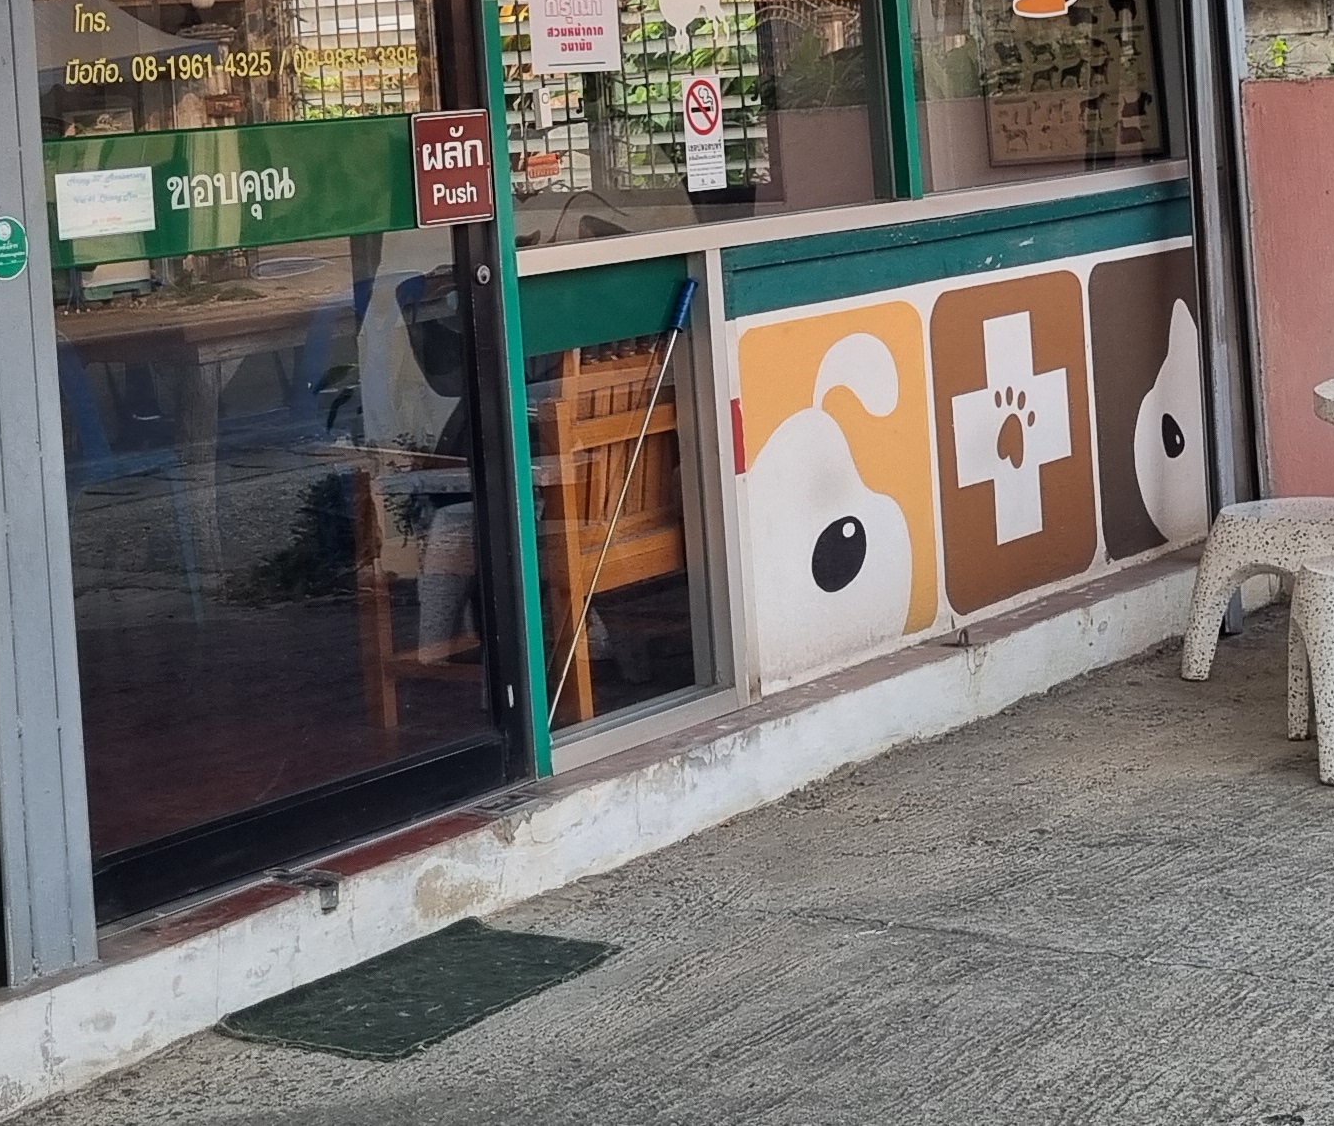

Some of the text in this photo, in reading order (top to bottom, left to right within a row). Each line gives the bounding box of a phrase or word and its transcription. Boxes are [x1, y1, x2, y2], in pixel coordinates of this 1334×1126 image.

[74, 4, 111, 34] โทร.
[547, 24, 604, 38] สวมหน้ากาก
[131, 51, 272, 83] 08-1961-4325
[293, 44, 418, 75] 08-9835-3395
[422, 125, 484, 171] ผลัก
[166, 165, 296, 220] ขอบคุณ
[433, 181, 478, 206] Push
